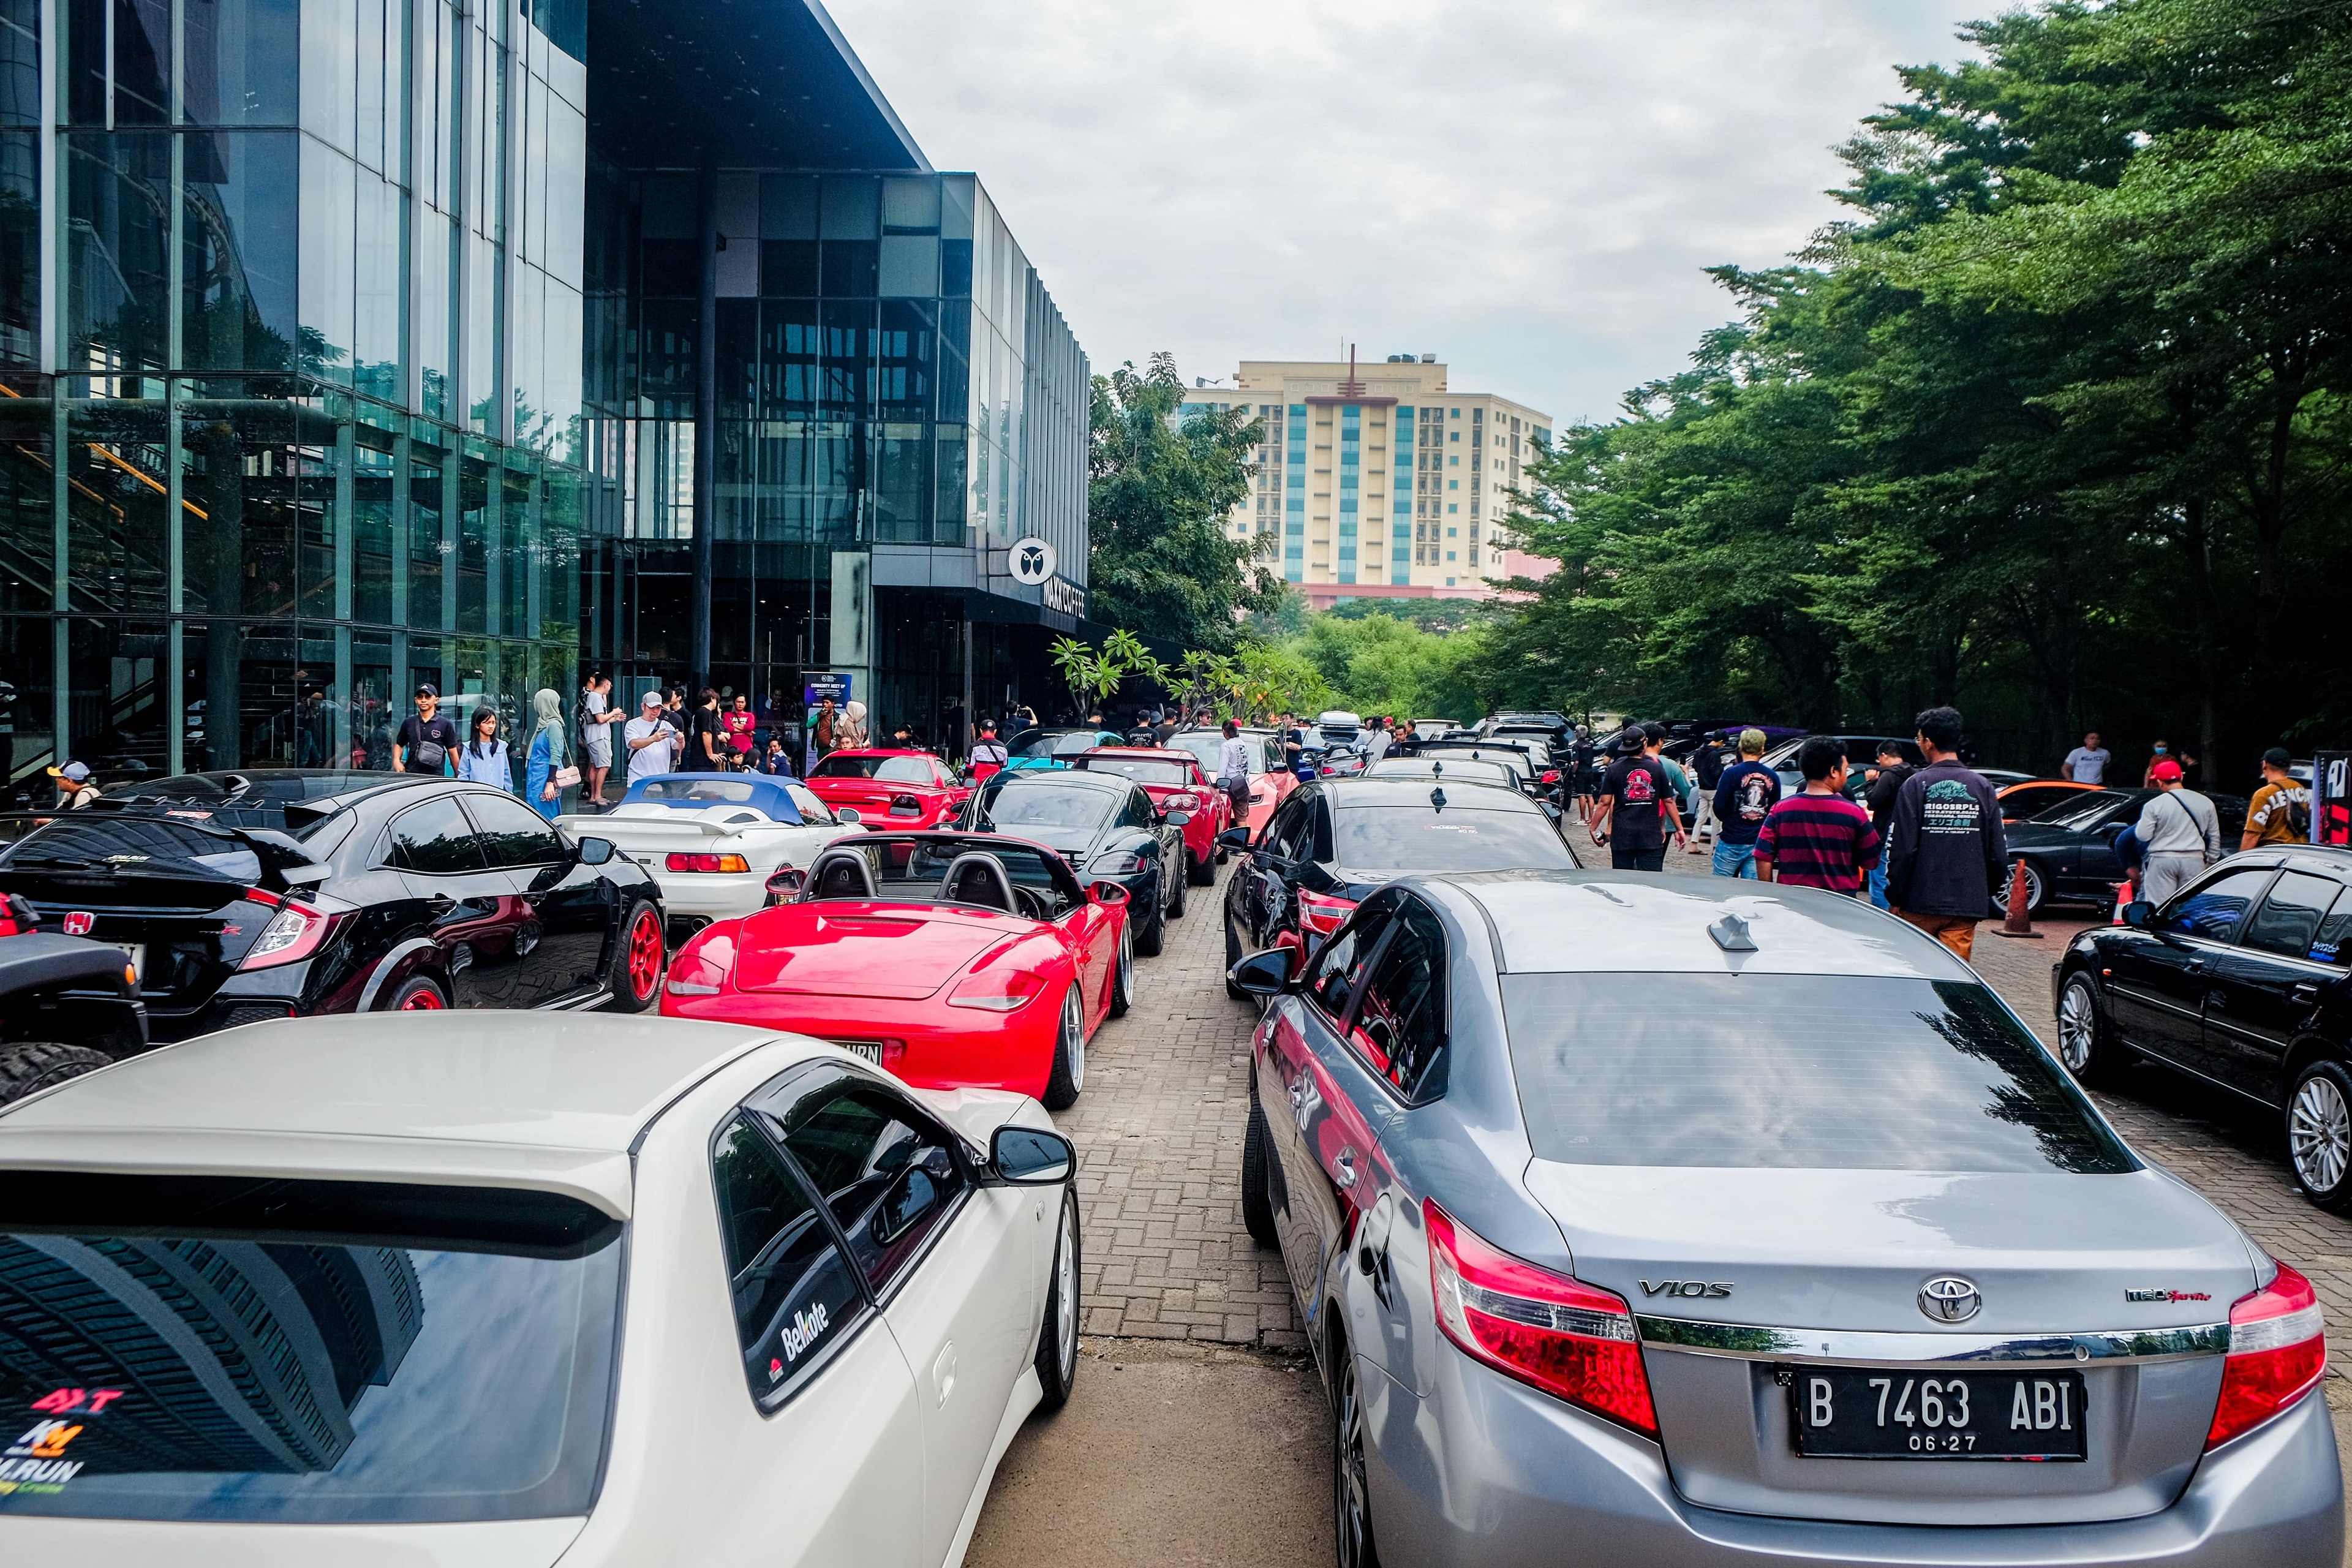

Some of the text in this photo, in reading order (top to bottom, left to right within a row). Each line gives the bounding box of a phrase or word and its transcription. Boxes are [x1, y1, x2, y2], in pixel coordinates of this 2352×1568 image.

[1043, 575, 1085, 619] MAXX COFFEE
[1638, 1279, 1735, 1298] VIOS
[2125, 1287, 2166, 1302] TRD
[781, 1302, 829, 1362] Belkote
[1810, 1378, 2072, 1430] B 7463 ABI
